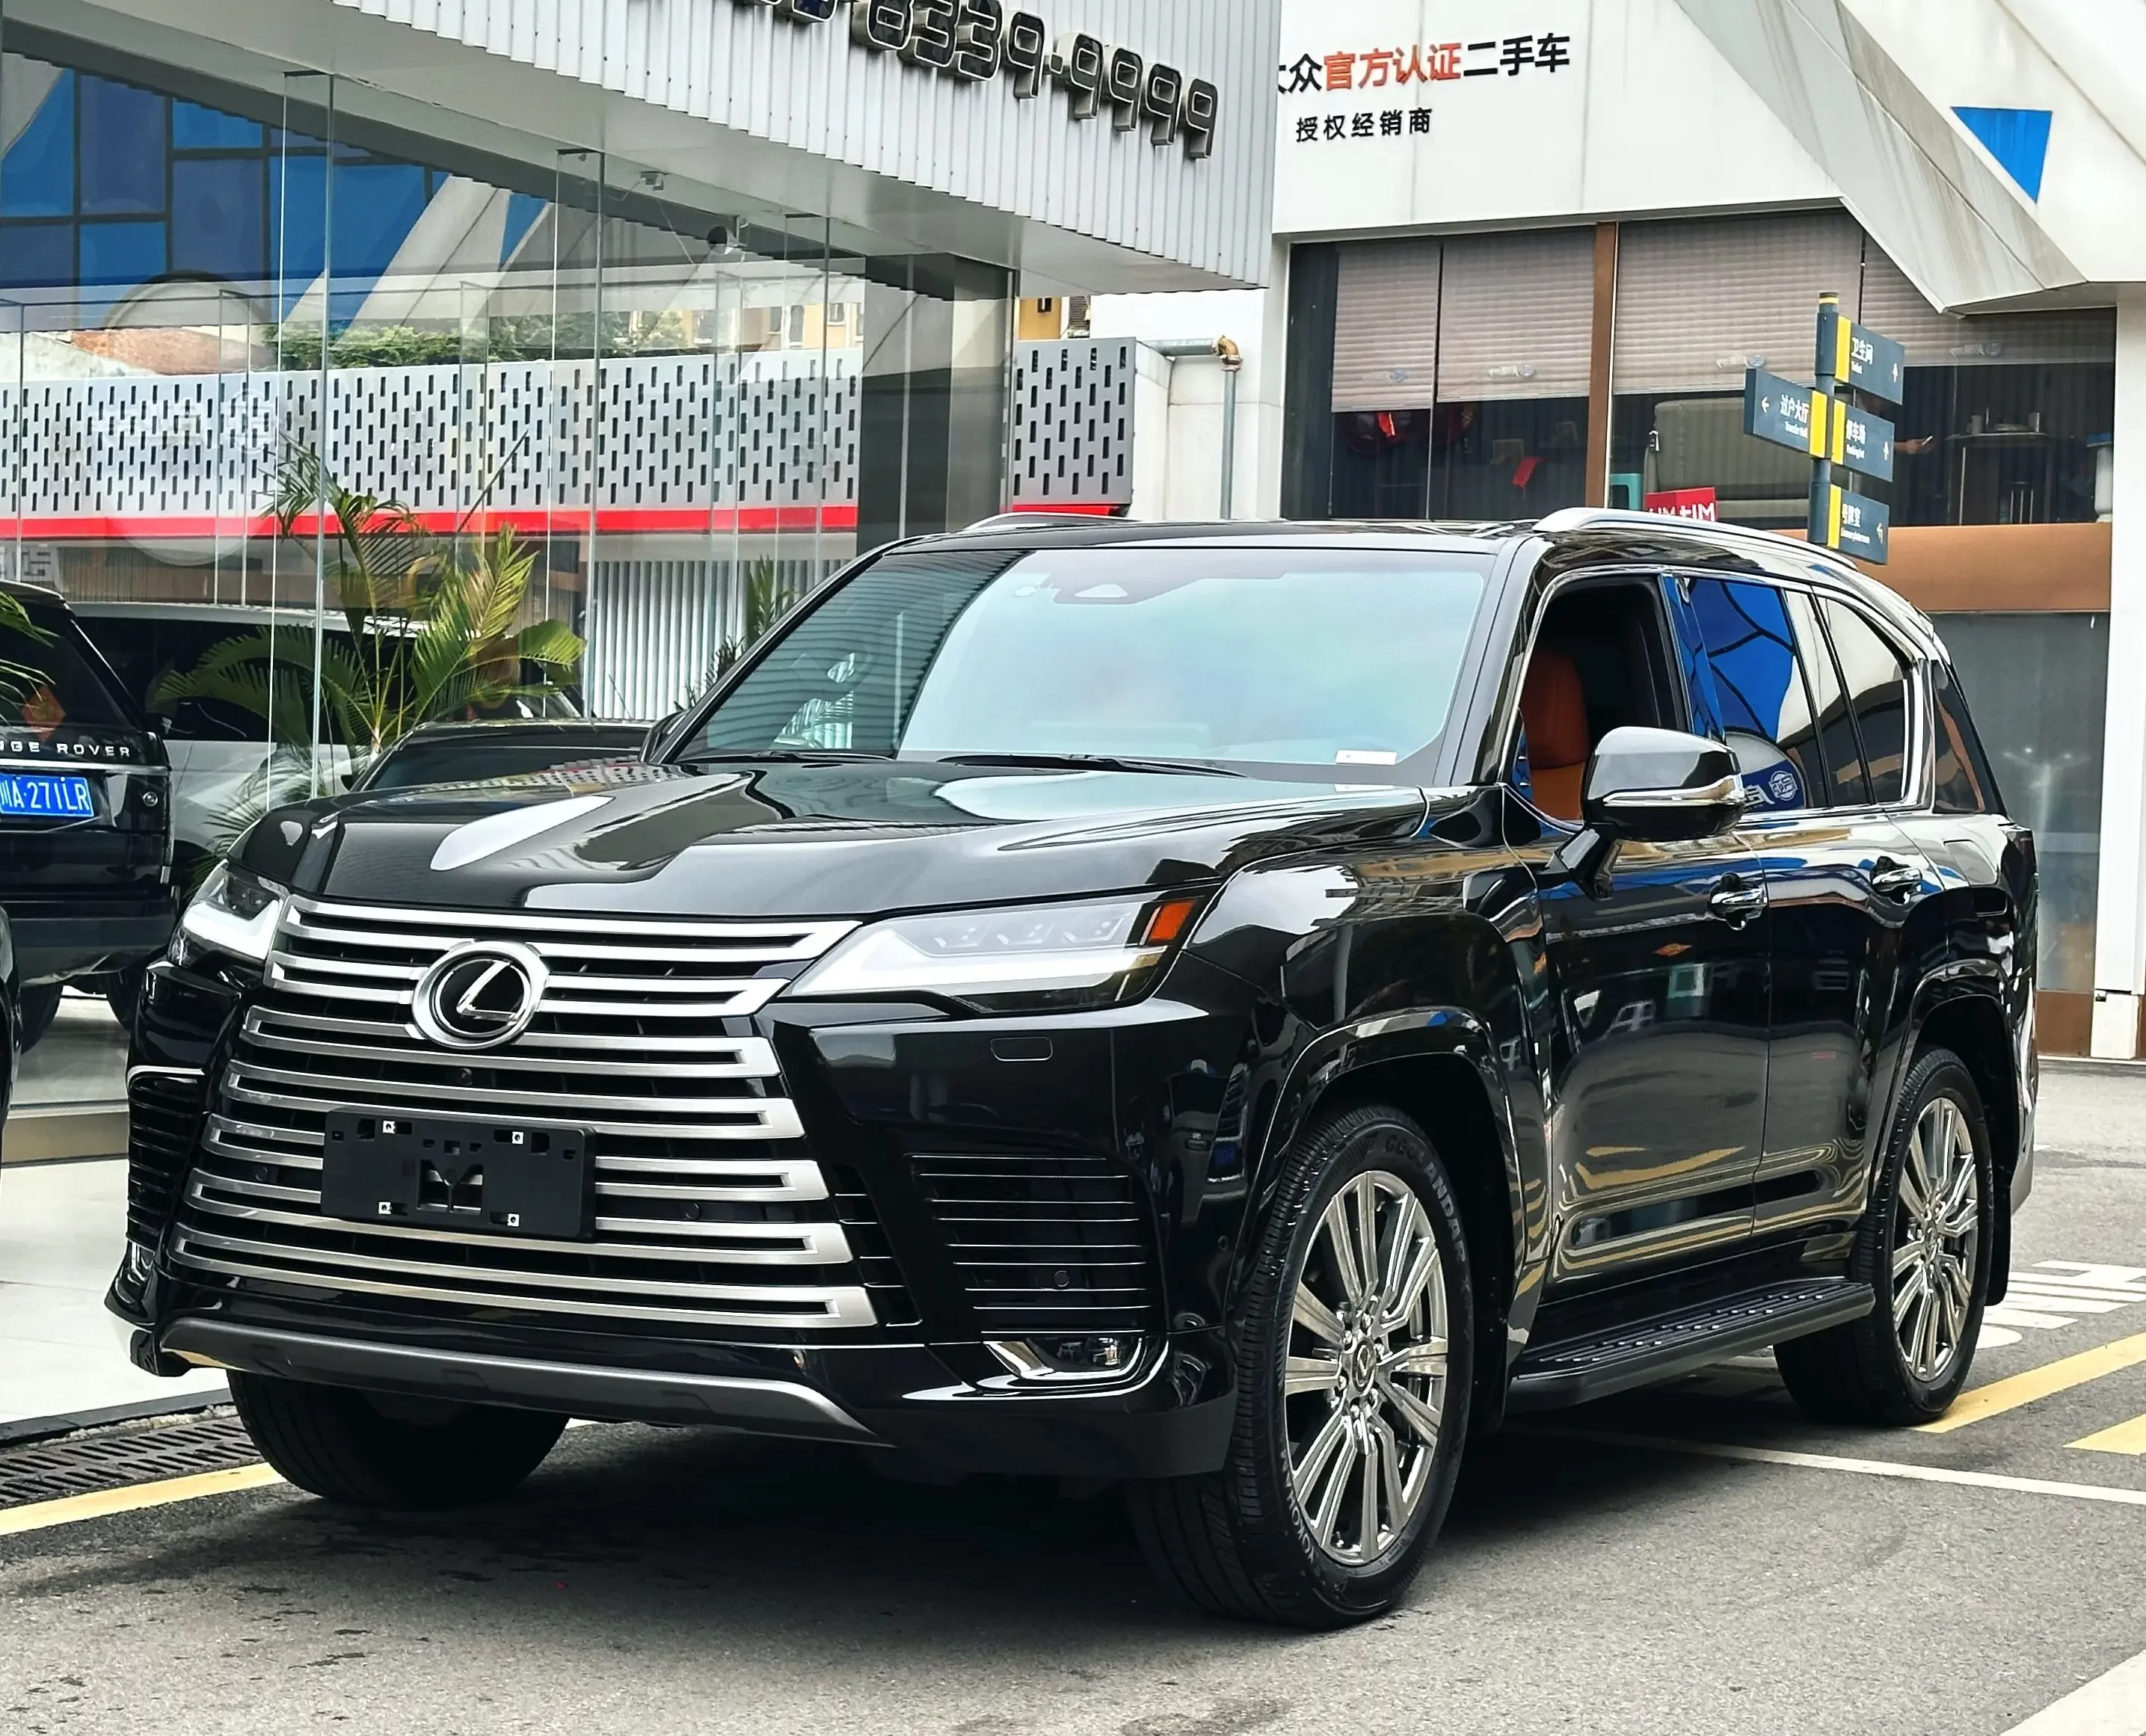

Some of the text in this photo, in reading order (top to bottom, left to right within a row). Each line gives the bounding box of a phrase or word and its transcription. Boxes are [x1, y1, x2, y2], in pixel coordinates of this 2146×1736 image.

[1295, 107, 1433, 143] 授权经销商
[57, 743, 130, 757] ROVER
